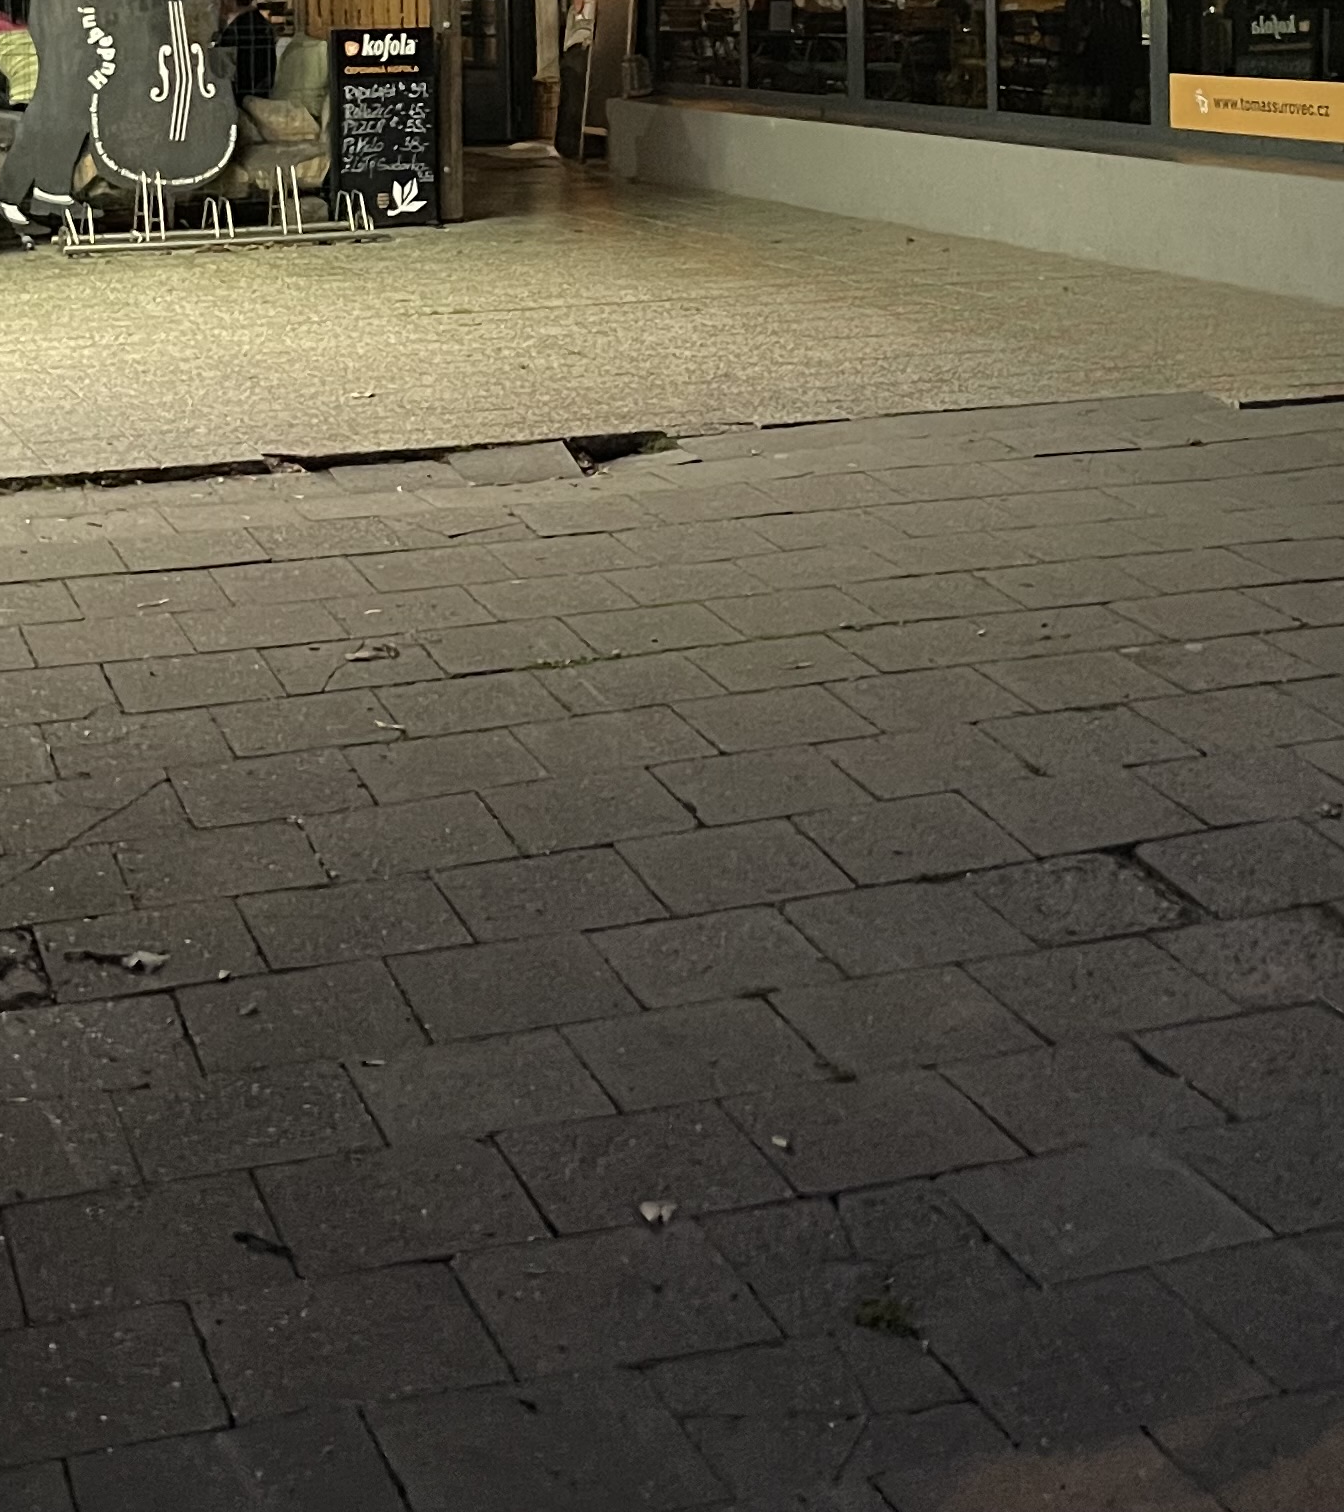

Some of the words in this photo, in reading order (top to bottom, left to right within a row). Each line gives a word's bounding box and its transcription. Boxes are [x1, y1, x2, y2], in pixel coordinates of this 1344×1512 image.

[77, 5, 116, 90] Hudební
[361, 32, 417, 62] kofola
[1213, 96, 1332, 119] www.tomassurovec.cz
